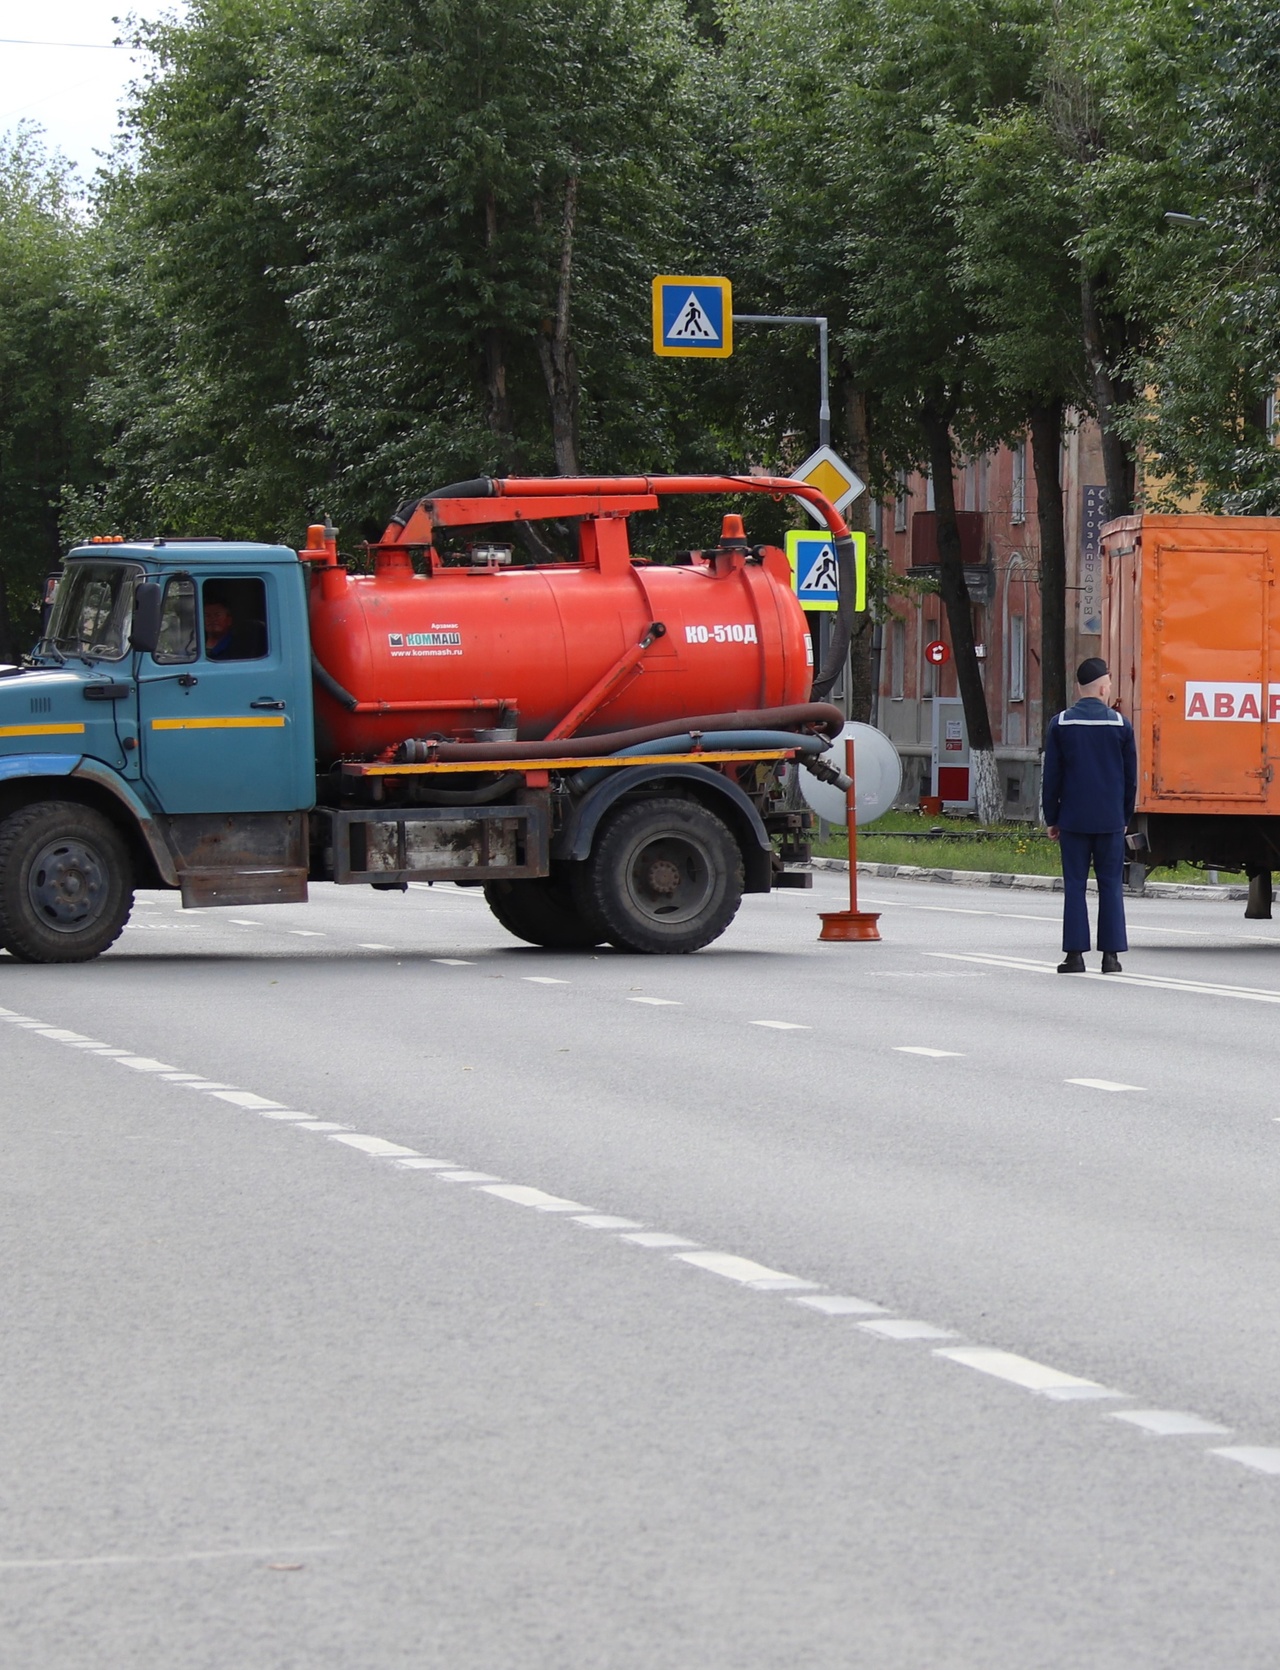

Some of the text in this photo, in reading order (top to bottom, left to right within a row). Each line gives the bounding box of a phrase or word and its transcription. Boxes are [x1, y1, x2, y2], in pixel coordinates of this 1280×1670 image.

[1084, 488, 1095, 615] АВТОЗАПЧАСТИ
[407, 633, 460, 645] КОММАШ
[685, 624, 758, 645] КО-510Д
[390, 649, 463, 657] www.kommash.ru
